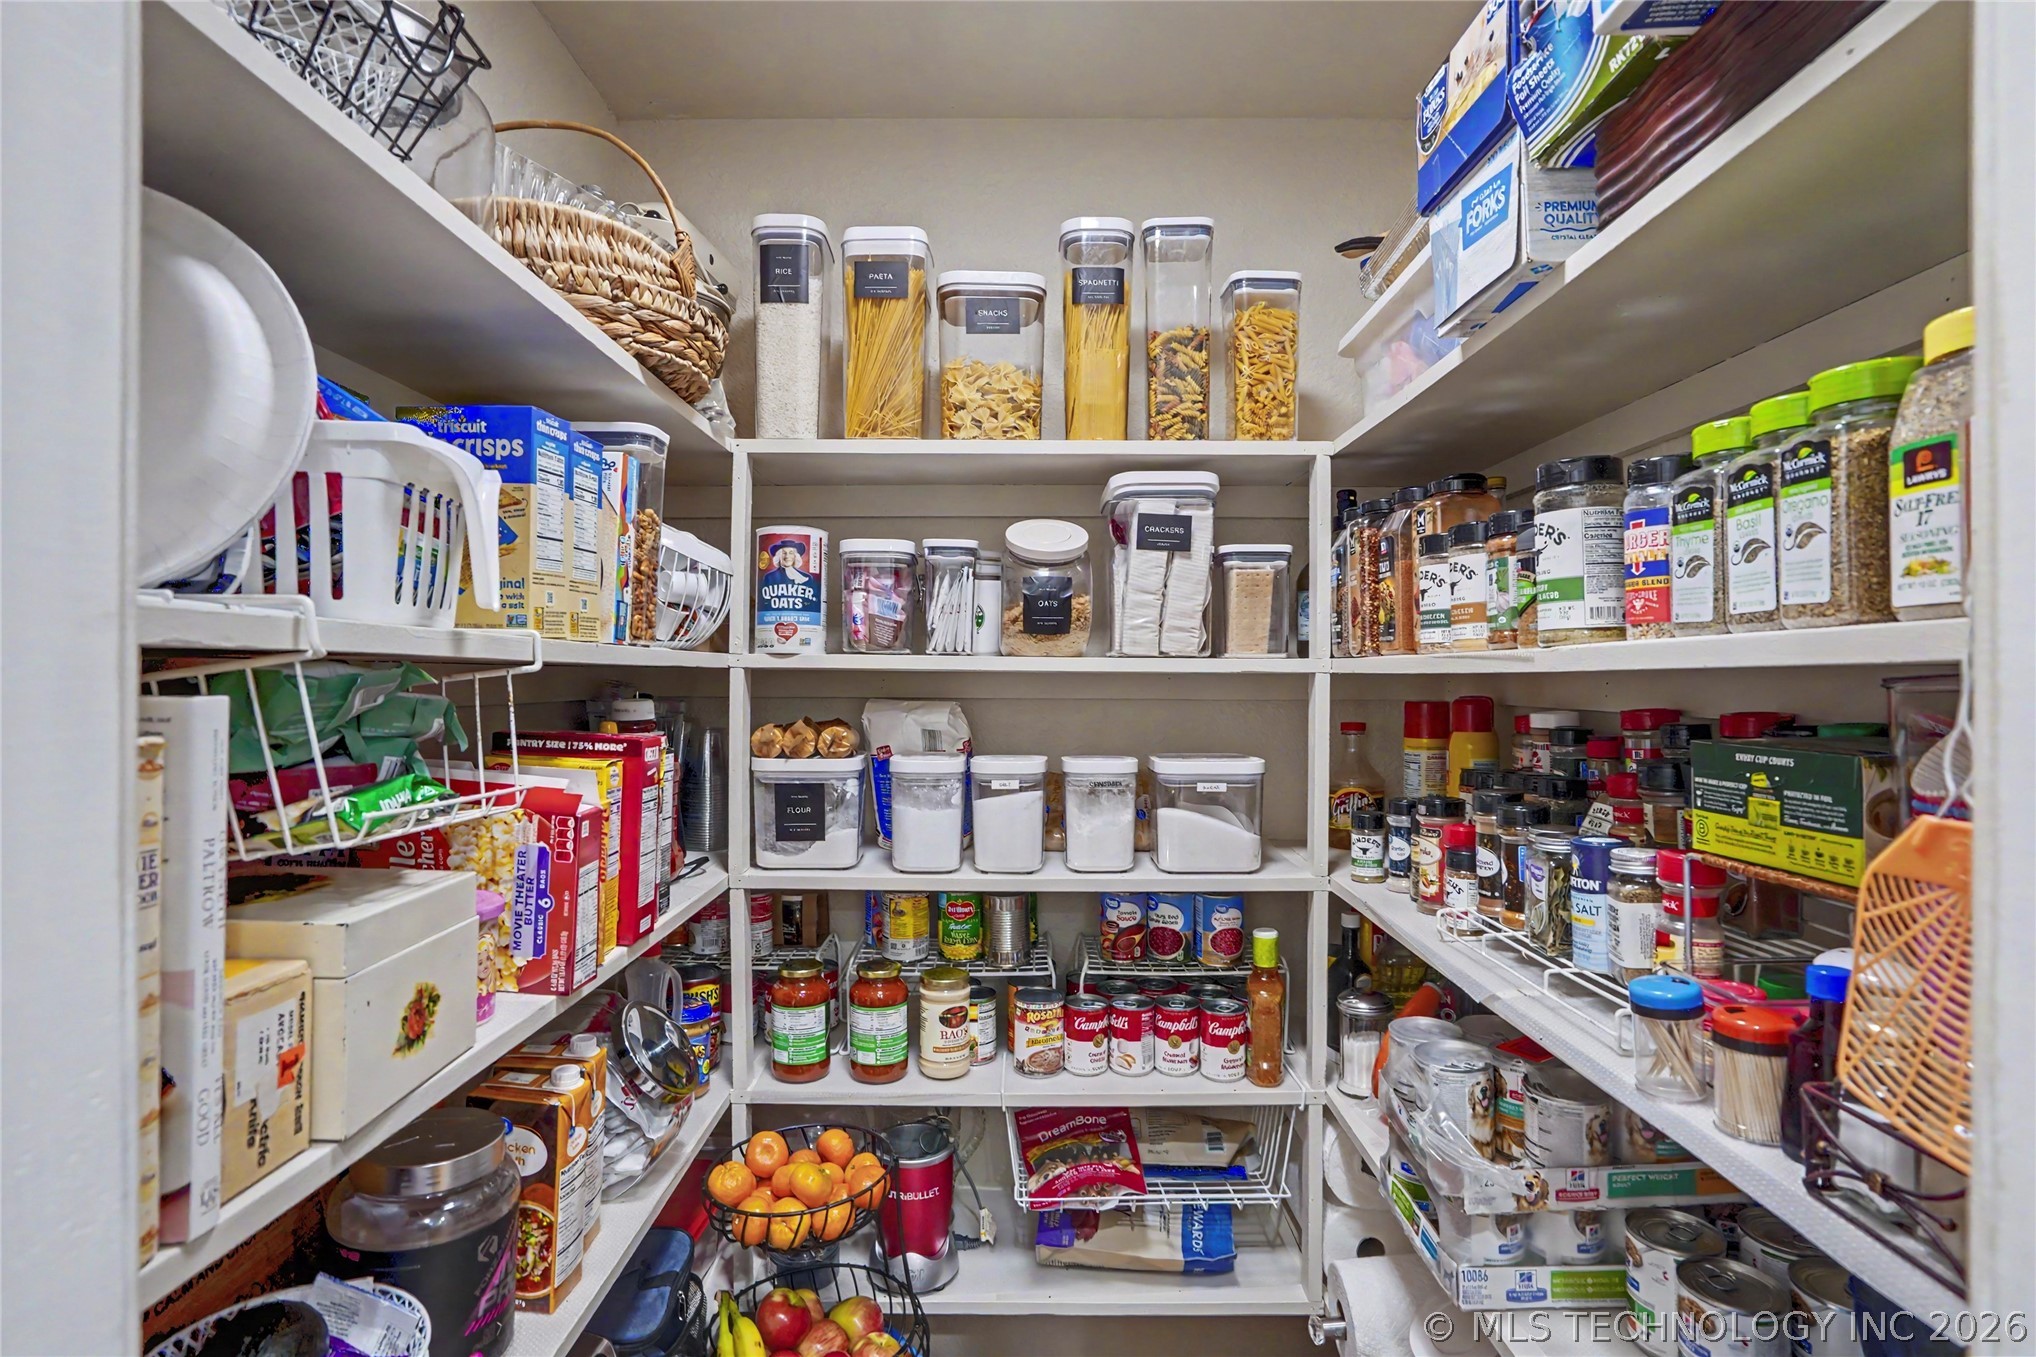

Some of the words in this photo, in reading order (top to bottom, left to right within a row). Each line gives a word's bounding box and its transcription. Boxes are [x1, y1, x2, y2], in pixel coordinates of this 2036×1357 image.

[1514, 85, 1531, 105] Foil
[1465, 185, 1507, 235] FORKS
[775, 267, 792, 275] RICE
[977, 309, 1008, 317] SNACKS
[437, 419, 487, 433] triscuit
[1783, 452, 1827, 470] McCormick
[1729, 473, 1769, 492] McCormick
[1675, 497, 1711, 513] McCormick
[1782, 494, 1829, 515] Oregano
[1736, 513, 1762, 531] Basil
[1916, 509, 1933, 527] 17
[1144, 525, 1185, 534] CRACKERS
[1675, 533, 1710, 548] Thyme
[1642, 578, 1670, 587] BLEND
[762, 584, 815, 601] QUAKER
[771, 597, 803, 609] OATS
[1037, 600, 1058, 608] OATS
[572, 742, 594, 751] 75%
[1755, 754, 1768, 764] CUP
[1768, 756, 1795, 767] COUNTS
[201, 837, 215, 929] PALTROW
[514, 849, 527, 905] THEATER
[523, 876, 535, 926] BUTTER
[538, 897, 551, 908] 6
[1575, 903, 1602, 916] SALT
[513, 905, 523, 951] MOVIE
[1155, 1013, 1198, 1033] Campbell's
[196, 1088, 212, 1147] GOOD
[1038, 1115, 1108, 1143] DreamBone
[1612, 1174, 1646, 1182] PERFECT
[1648, 1173, 1679, 1181] WEIGHT
[1461, 1270, 1489, 1283] 10086
